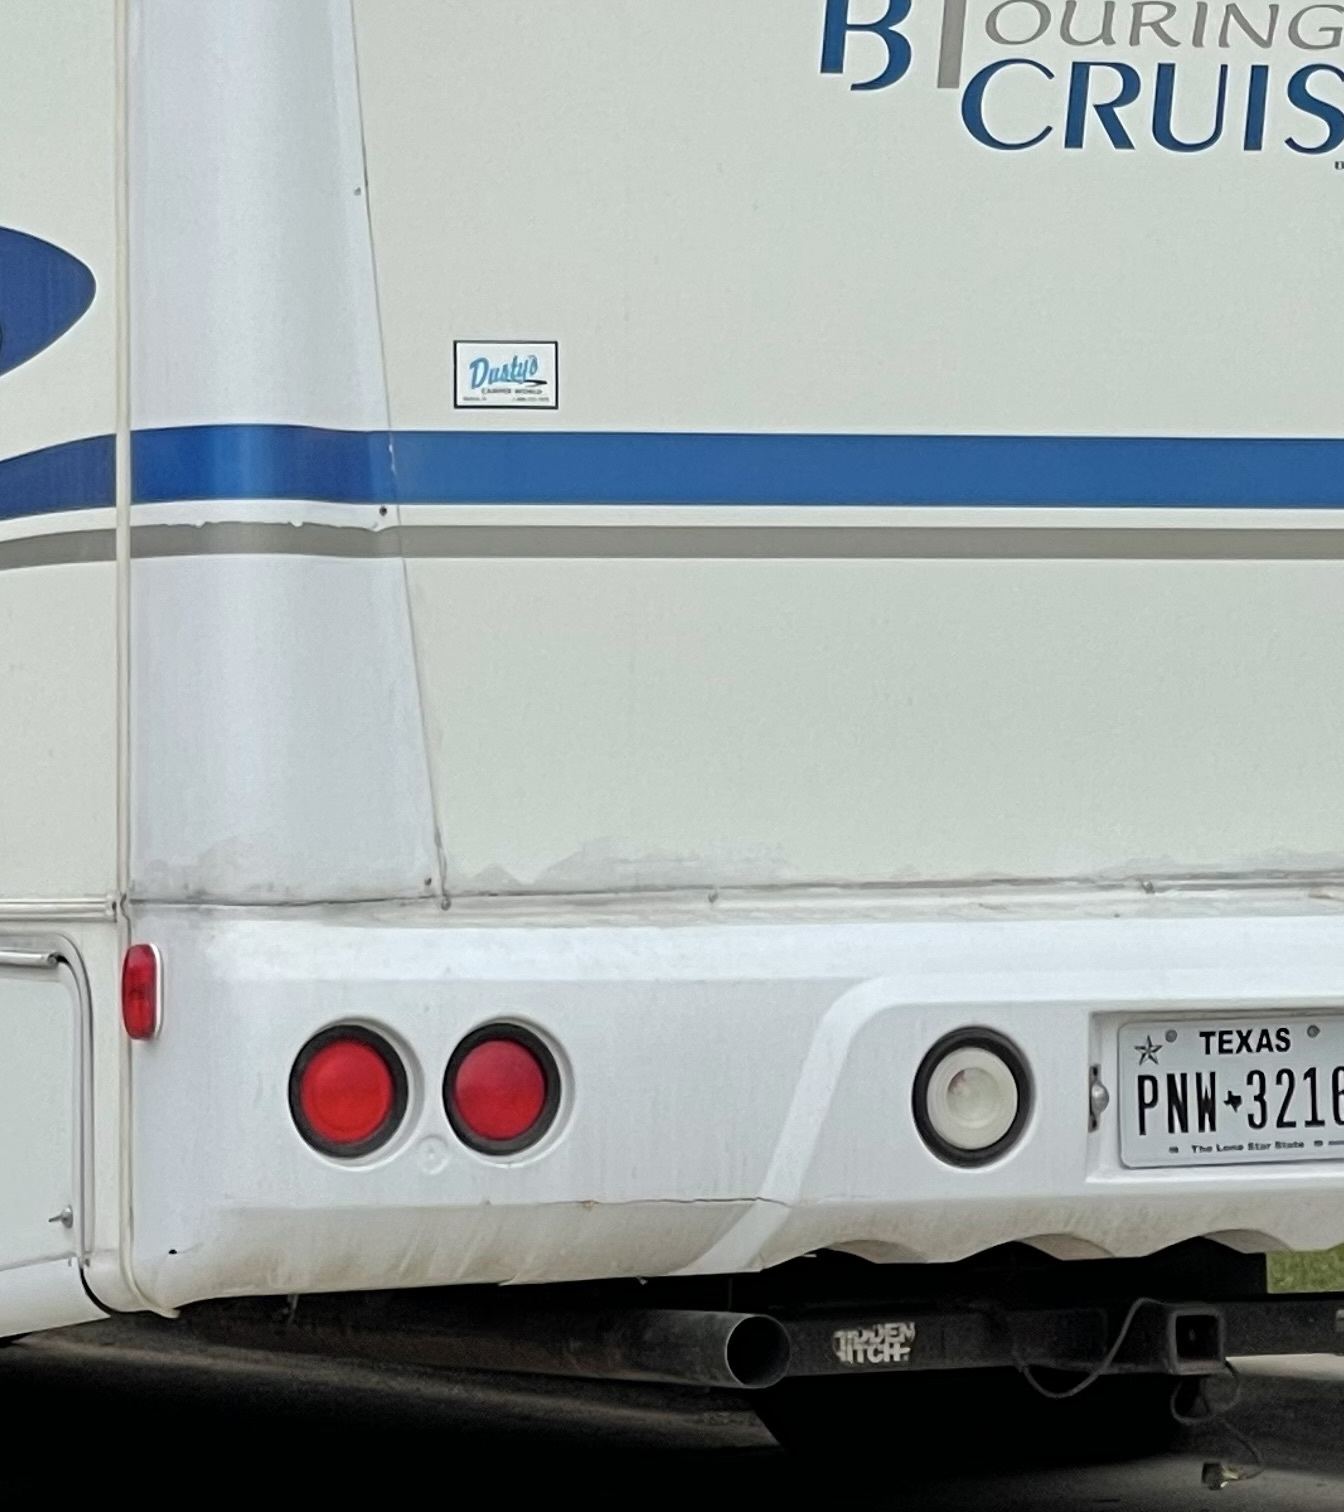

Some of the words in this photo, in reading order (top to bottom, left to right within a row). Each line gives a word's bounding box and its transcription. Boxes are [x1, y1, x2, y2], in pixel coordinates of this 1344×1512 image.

[1199, 1028, 1291, 1055] TEXAS
[1191, 1144, 1213, 1154] The
[1216, 1143, 1244, 1152] Lone
[1247, 1141, 1272, 1151] Star
[1275, 1140, 1305, 1149] State
